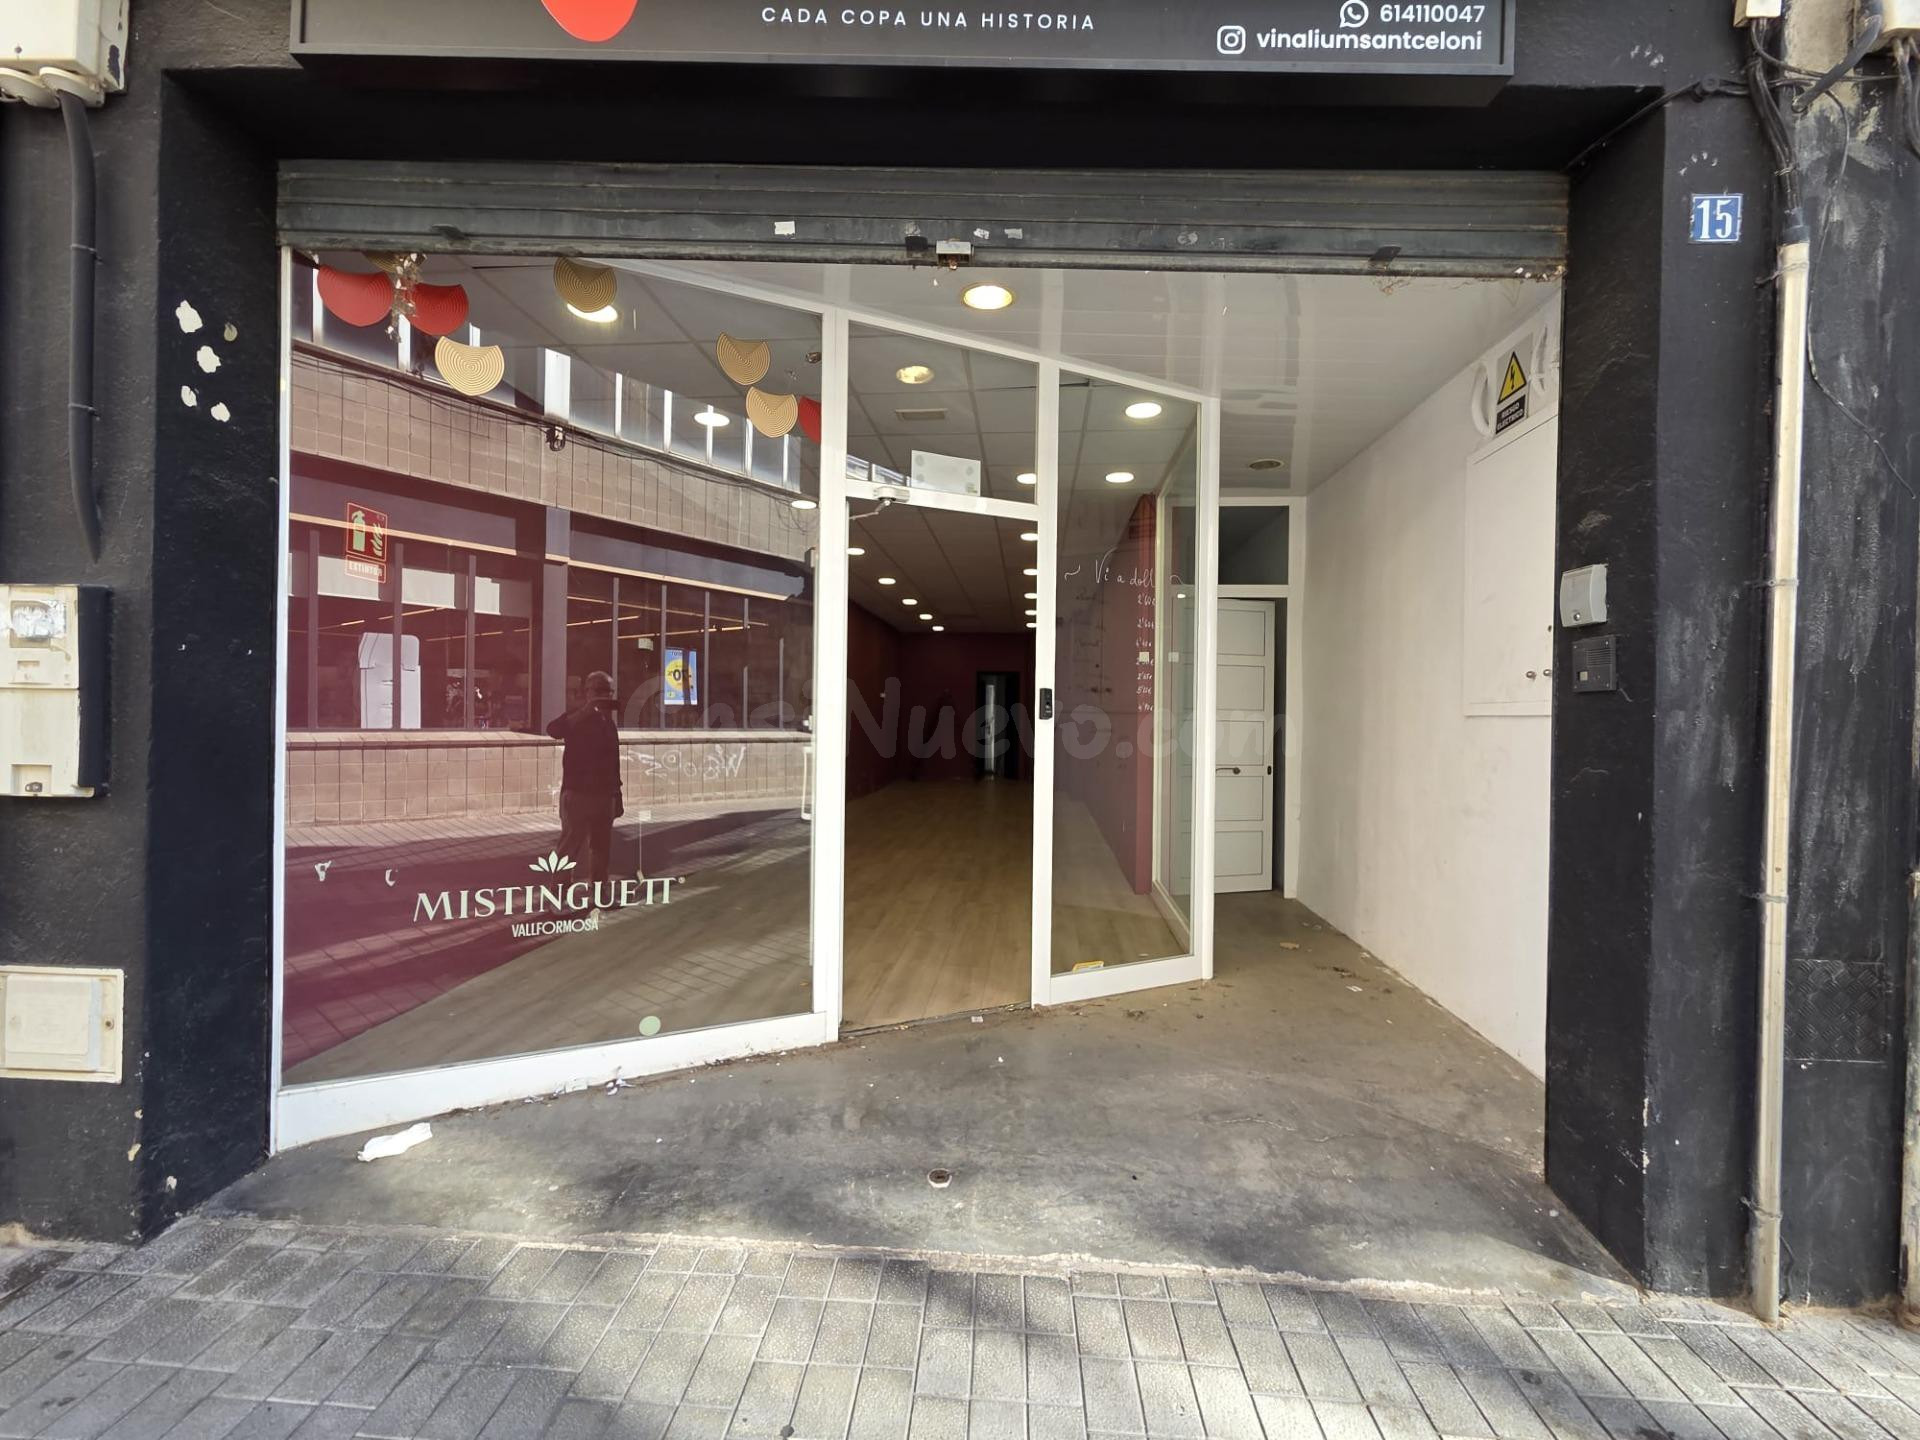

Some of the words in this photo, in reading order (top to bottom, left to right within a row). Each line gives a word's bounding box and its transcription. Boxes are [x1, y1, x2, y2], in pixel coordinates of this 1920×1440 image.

[761, 7, 828, 24] CADA
[841, 9, 907, 26] COPA
[920, 11, 968, 28] UNA
[980, 13, 1095, 30] HISTORIA
[1379, 4, 1486, 24] 614110047
[1256, 28, 1483, 51] vinaliumsantceloni
[1696, 199, 1733, 239] 15
[413, 877, 678, 923] MISTINGUETT
[511, 918, 599, 938] VALLFORMOSA
